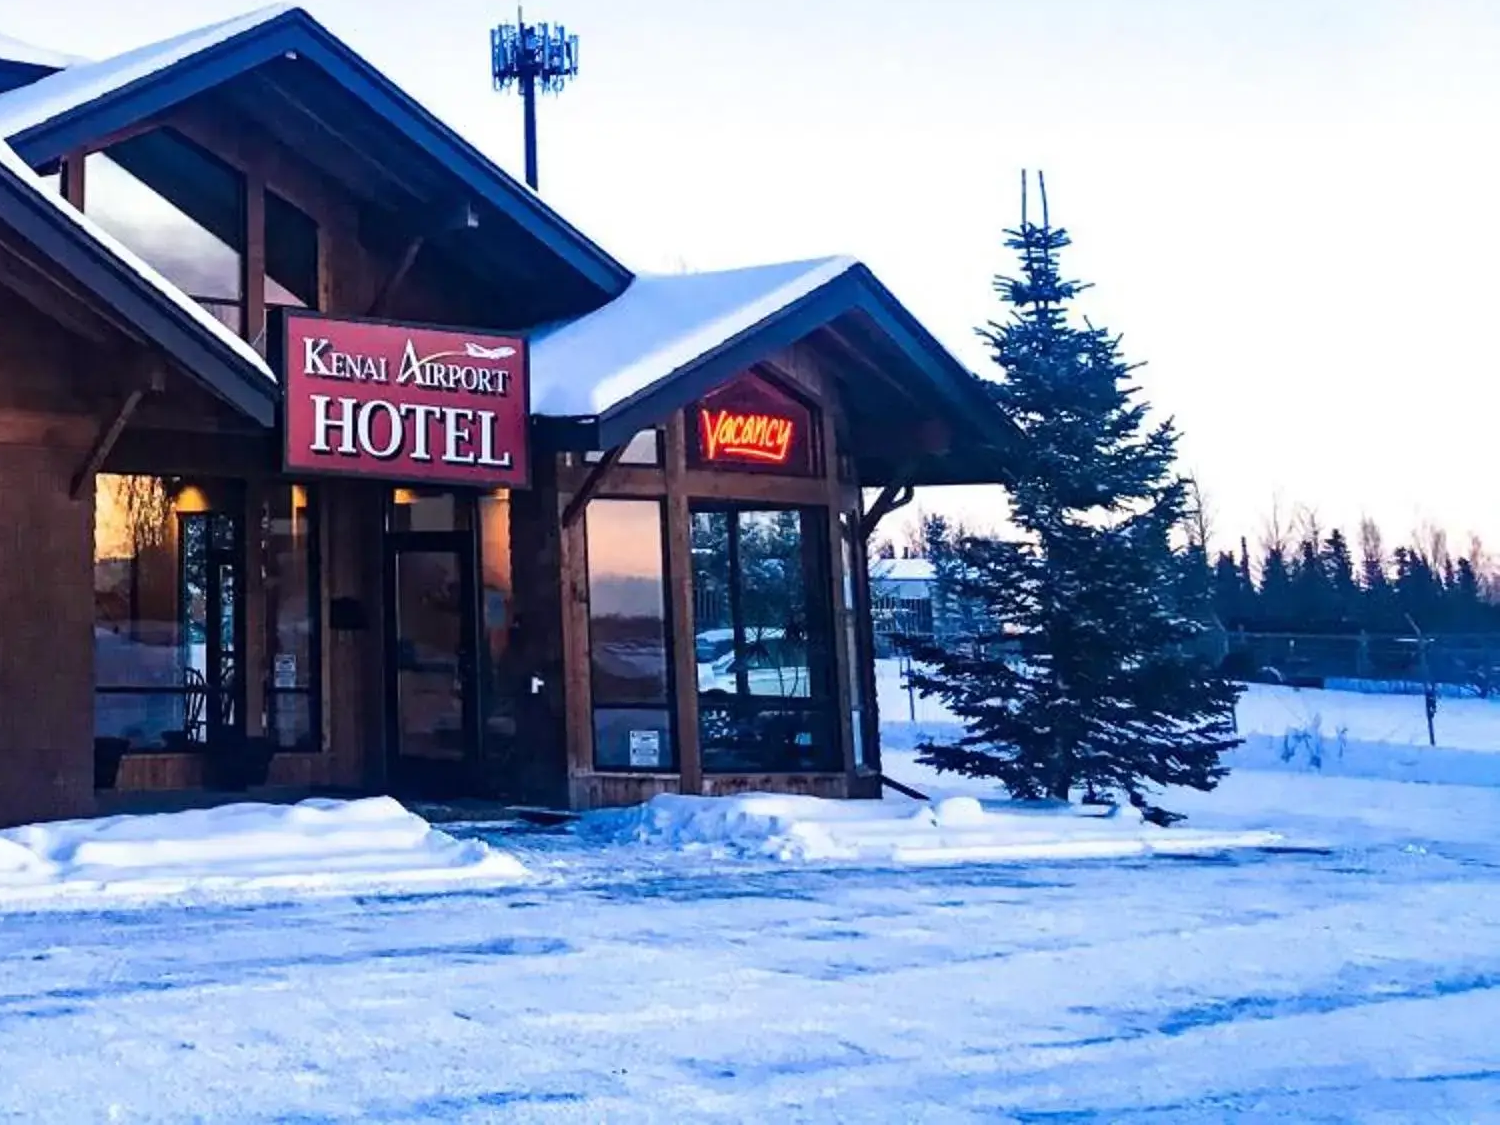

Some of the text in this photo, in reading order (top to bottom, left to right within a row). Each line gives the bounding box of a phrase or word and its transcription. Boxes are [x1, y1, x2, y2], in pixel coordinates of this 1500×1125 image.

[303, 337, 509, 393] KENAI AIRPORT
[310, 395, 510, 466] HOTEL
[702, 410, 793, 460] Vacancy
